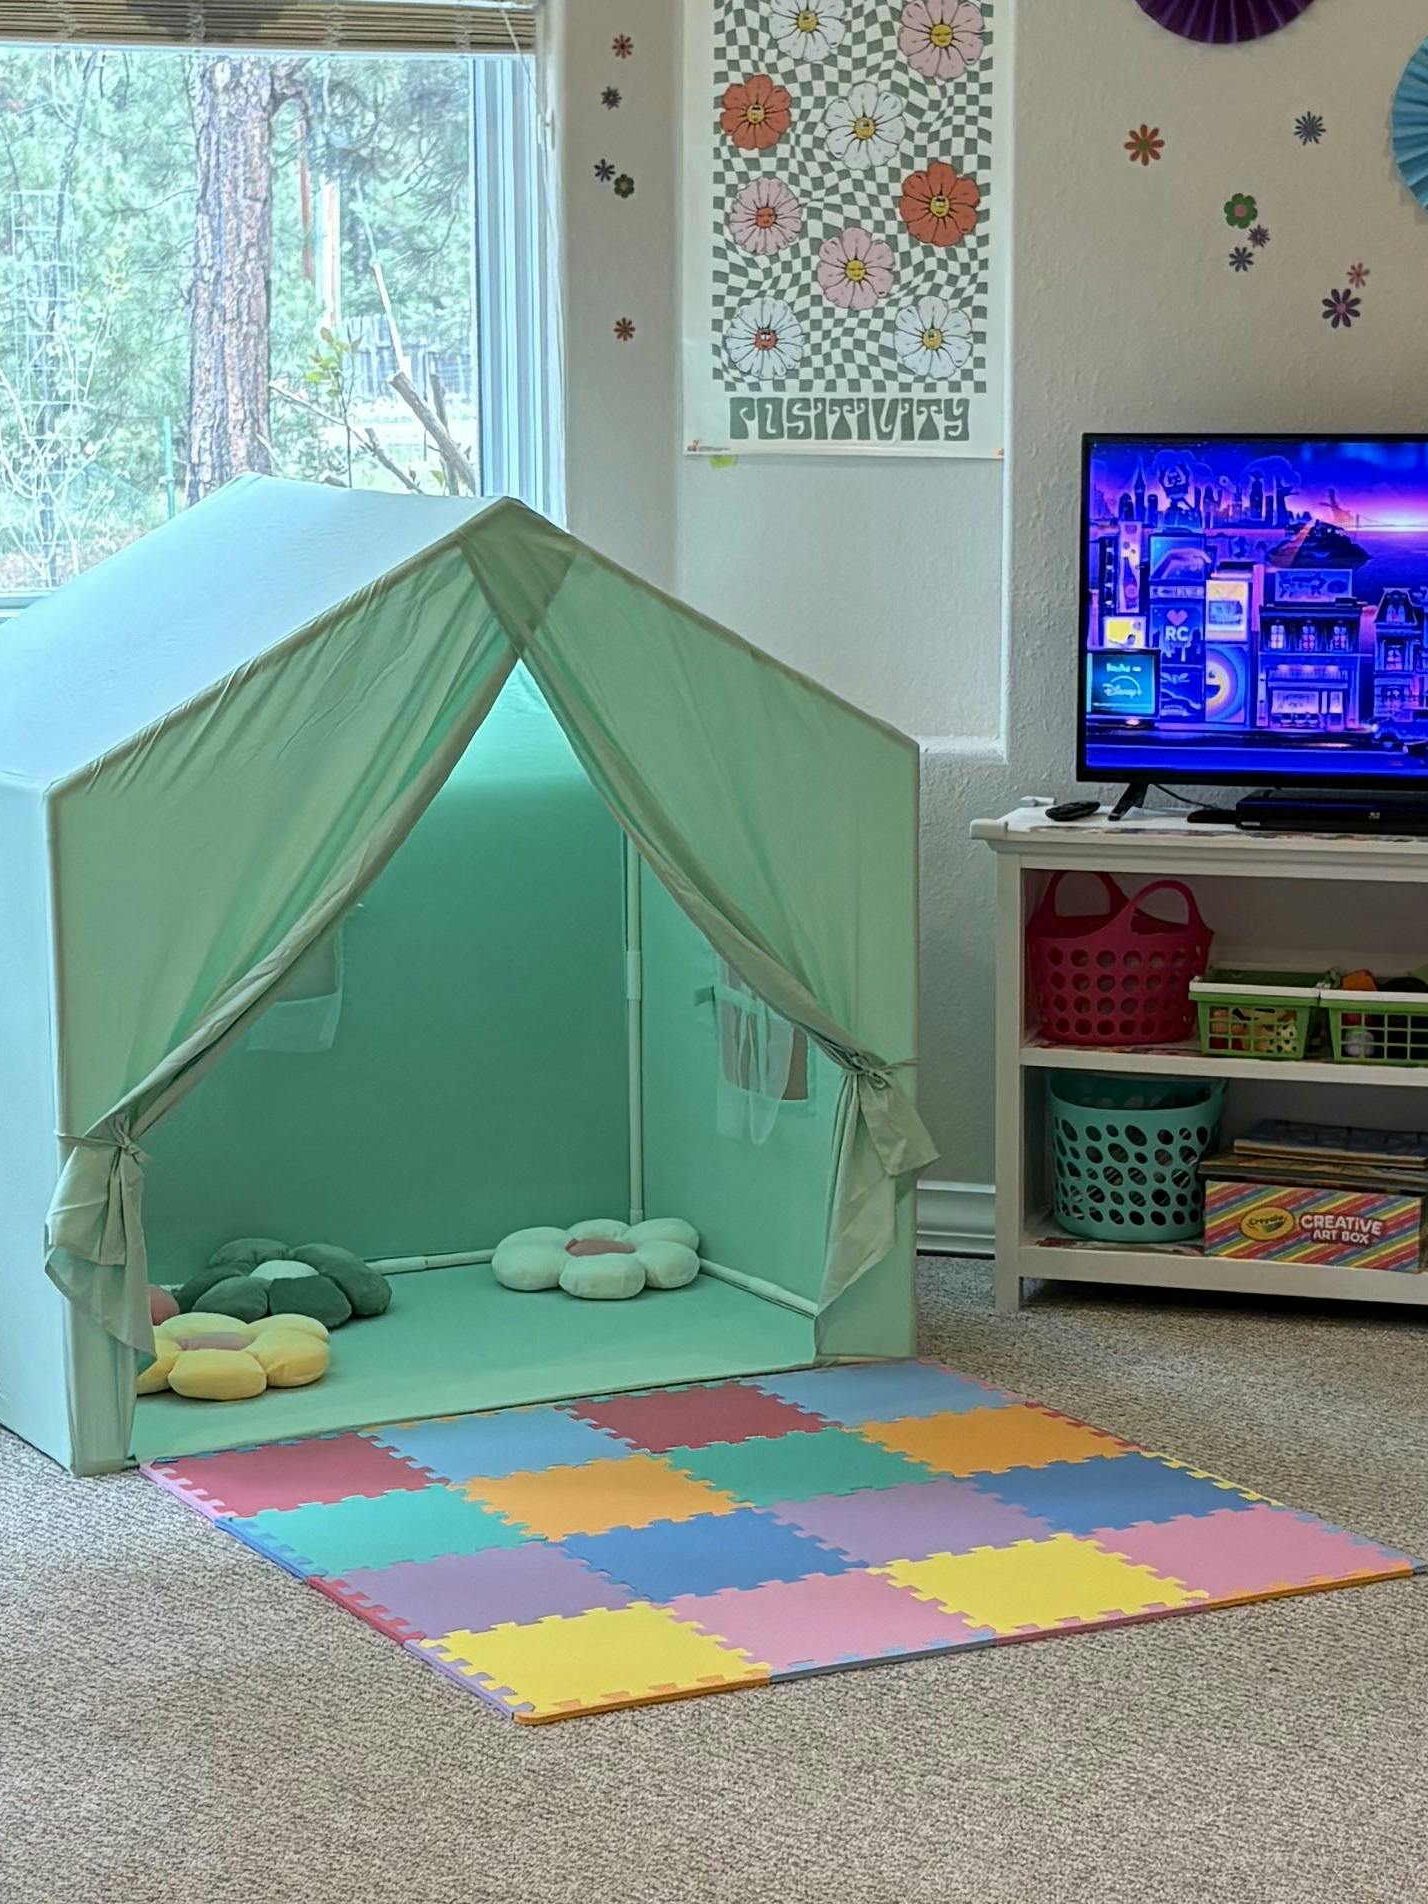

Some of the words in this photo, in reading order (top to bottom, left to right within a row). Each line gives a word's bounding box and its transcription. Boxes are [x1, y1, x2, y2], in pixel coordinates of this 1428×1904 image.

[729, 397, 970, 441] POSITIVITY
[1300, 1213, 1384, 1236] CREATIVE
[1313, 1229, 1339, 1241] ART
[1341, 1231, 1370, 1244] BOX
